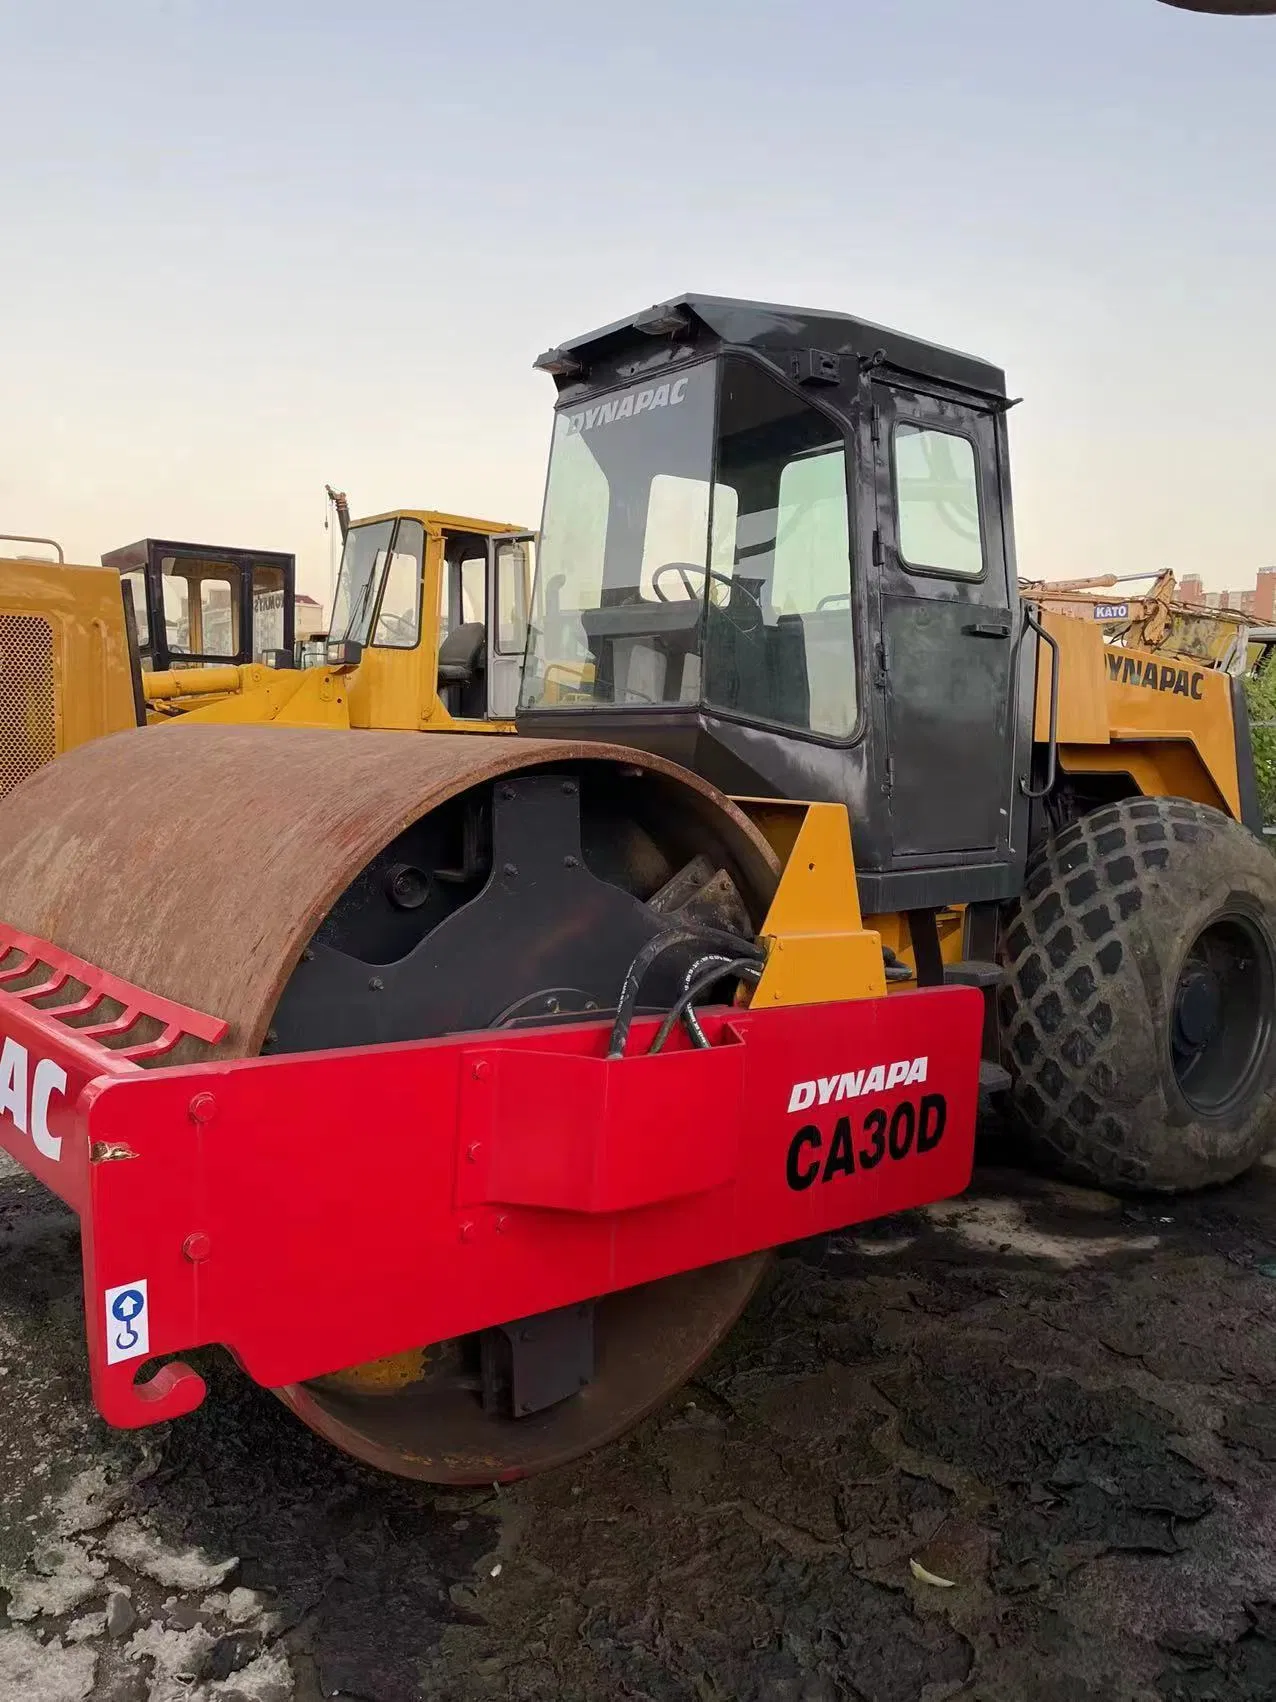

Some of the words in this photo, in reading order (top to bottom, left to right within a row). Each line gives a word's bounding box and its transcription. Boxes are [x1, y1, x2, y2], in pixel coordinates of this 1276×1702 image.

[566, 378, 688, 436] DYNAPAC
[1096, 605, 1127, 620] KATO
[1104, 652, 1204, 700] YNAPAC
[787, 1056, 929, 1113] DYNAPA
[786, 1093, 947, 1191] CA30D
